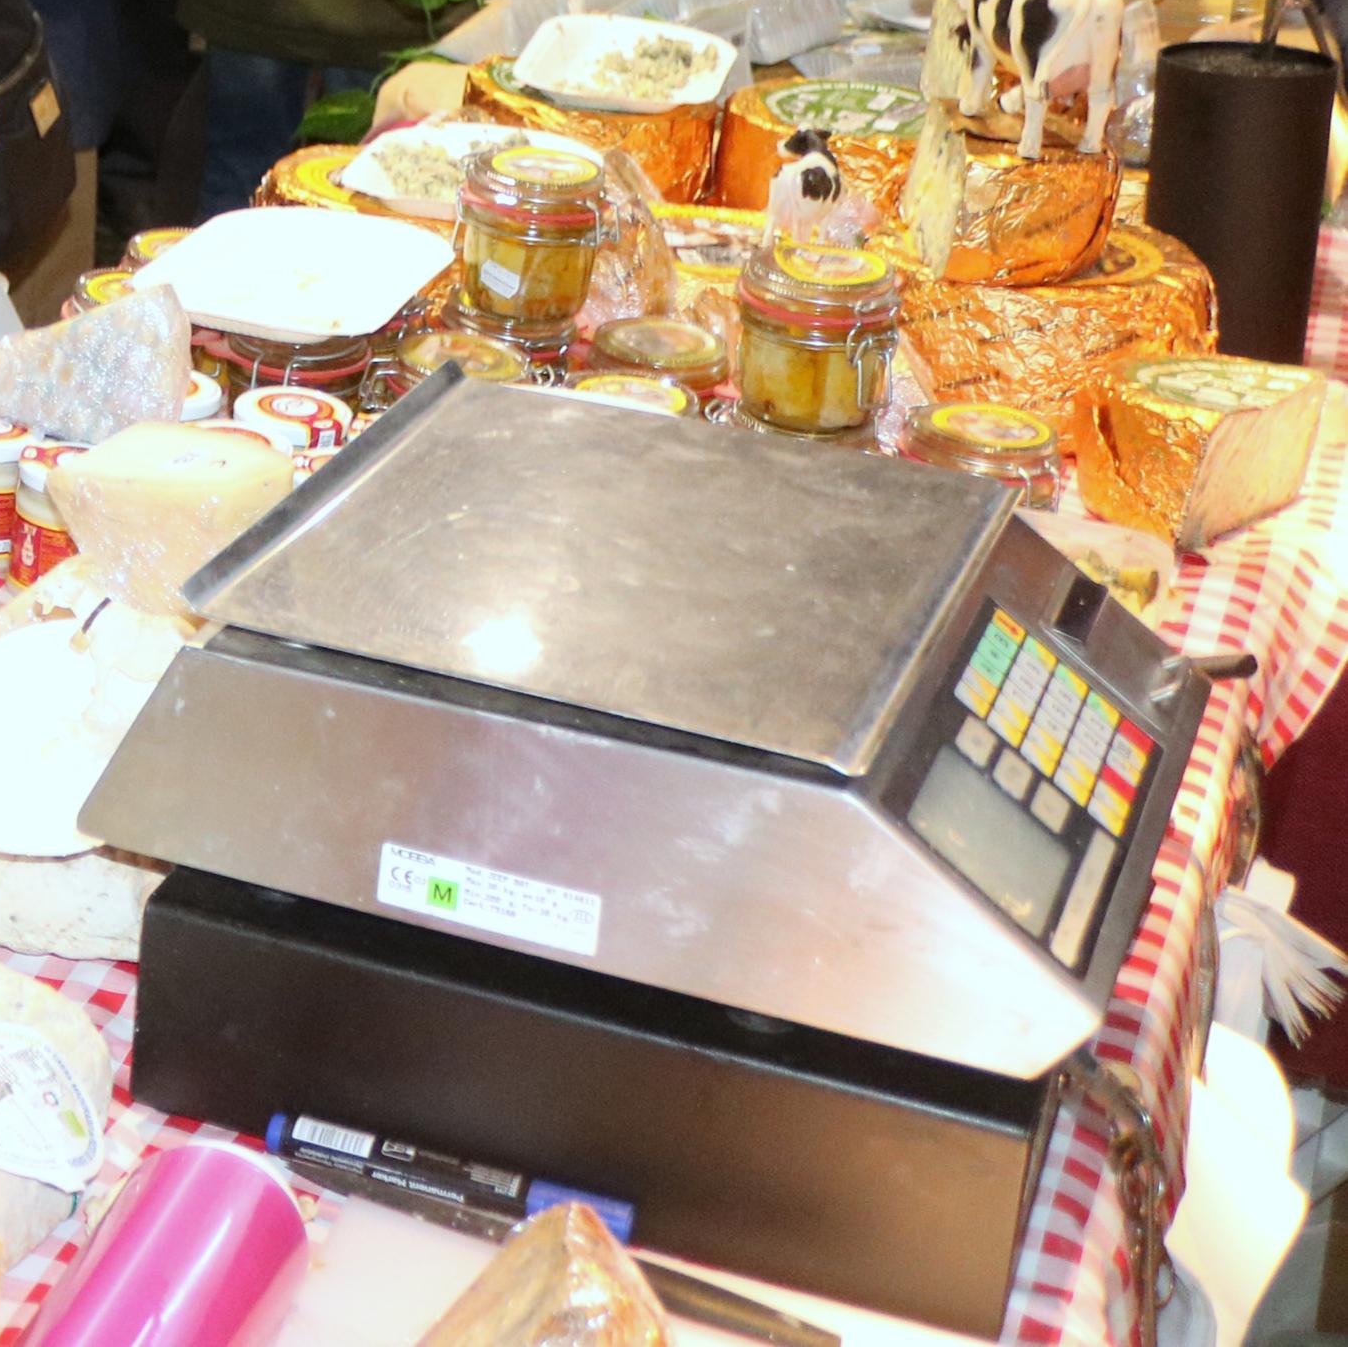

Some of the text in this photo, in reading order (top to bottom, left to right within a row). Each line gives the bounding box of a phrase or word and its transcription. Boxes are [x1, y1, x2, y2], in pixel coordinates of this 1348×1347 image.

[433, 883, 452, 903] M
[371, 1169, 464, 1203] Permanent Marker
